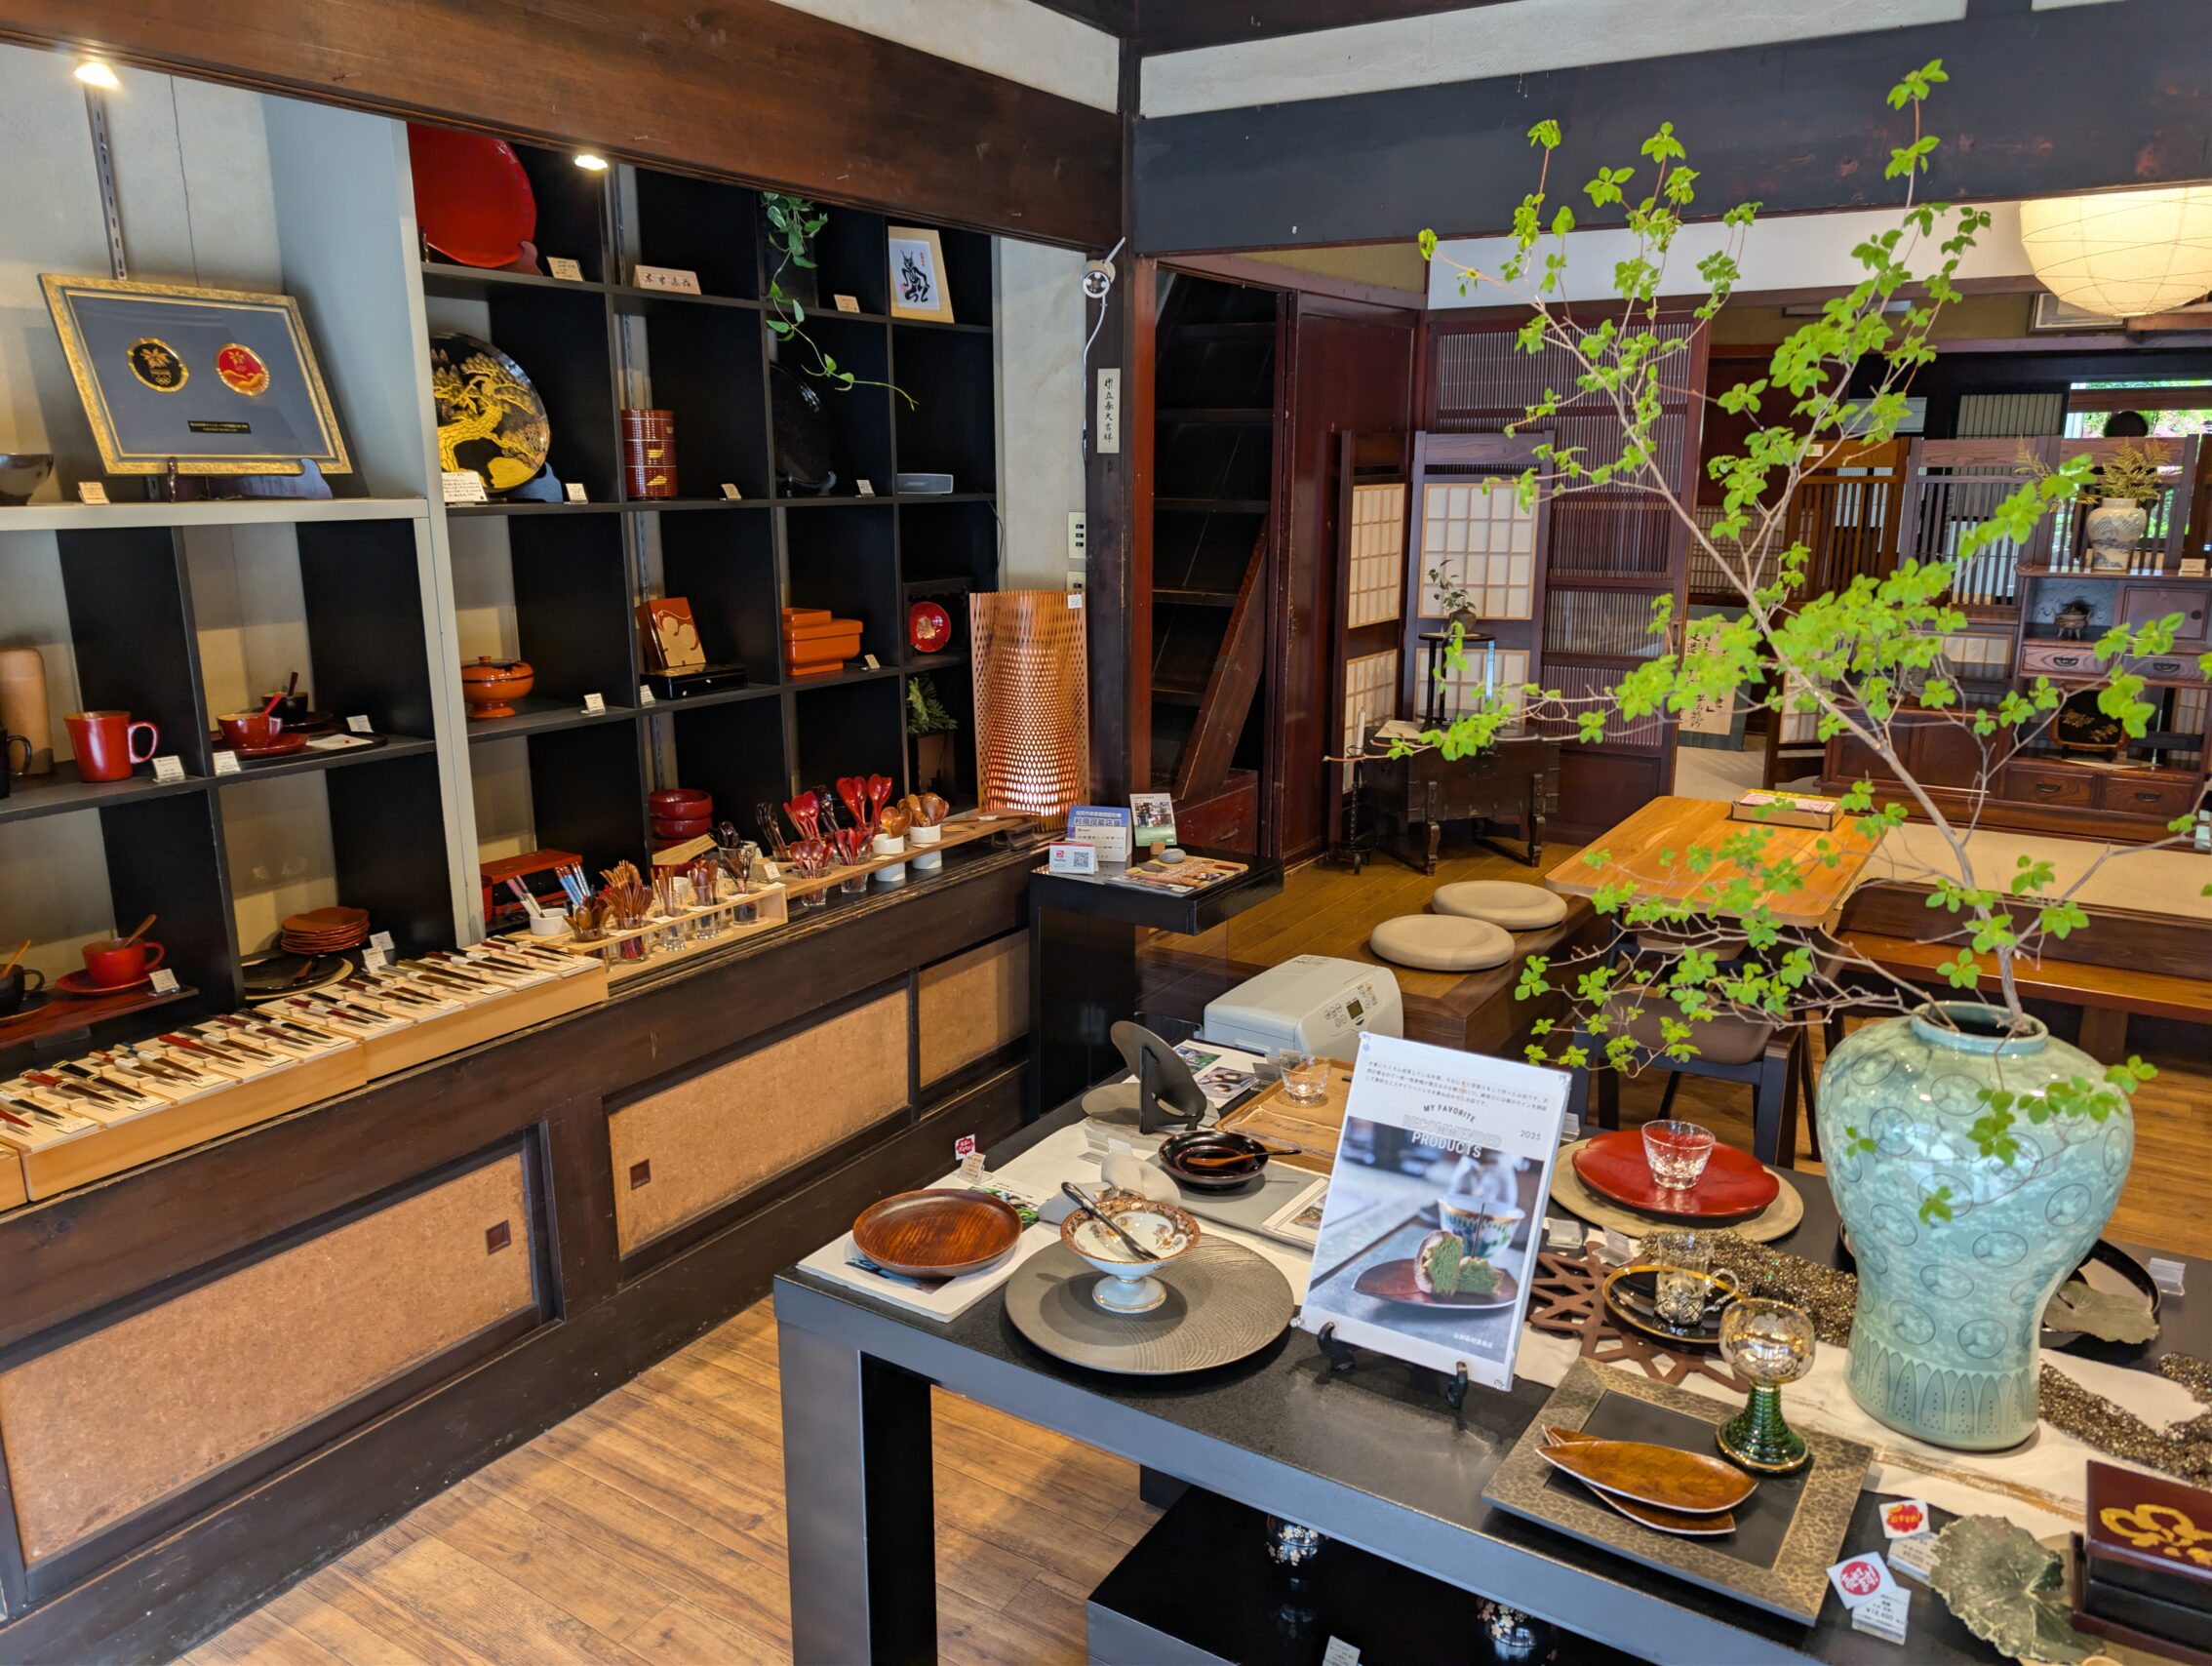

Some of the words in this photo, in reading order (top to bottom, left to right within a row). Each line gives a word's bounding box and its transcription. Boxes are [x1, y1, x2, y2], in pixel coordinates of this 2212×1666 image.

[1437, 1104, 1477, 1124] FAVORITE
[1410, 1130, 1482, 1159] PRODUCTS
[1520, 1130, 1542, 1141] 2025
